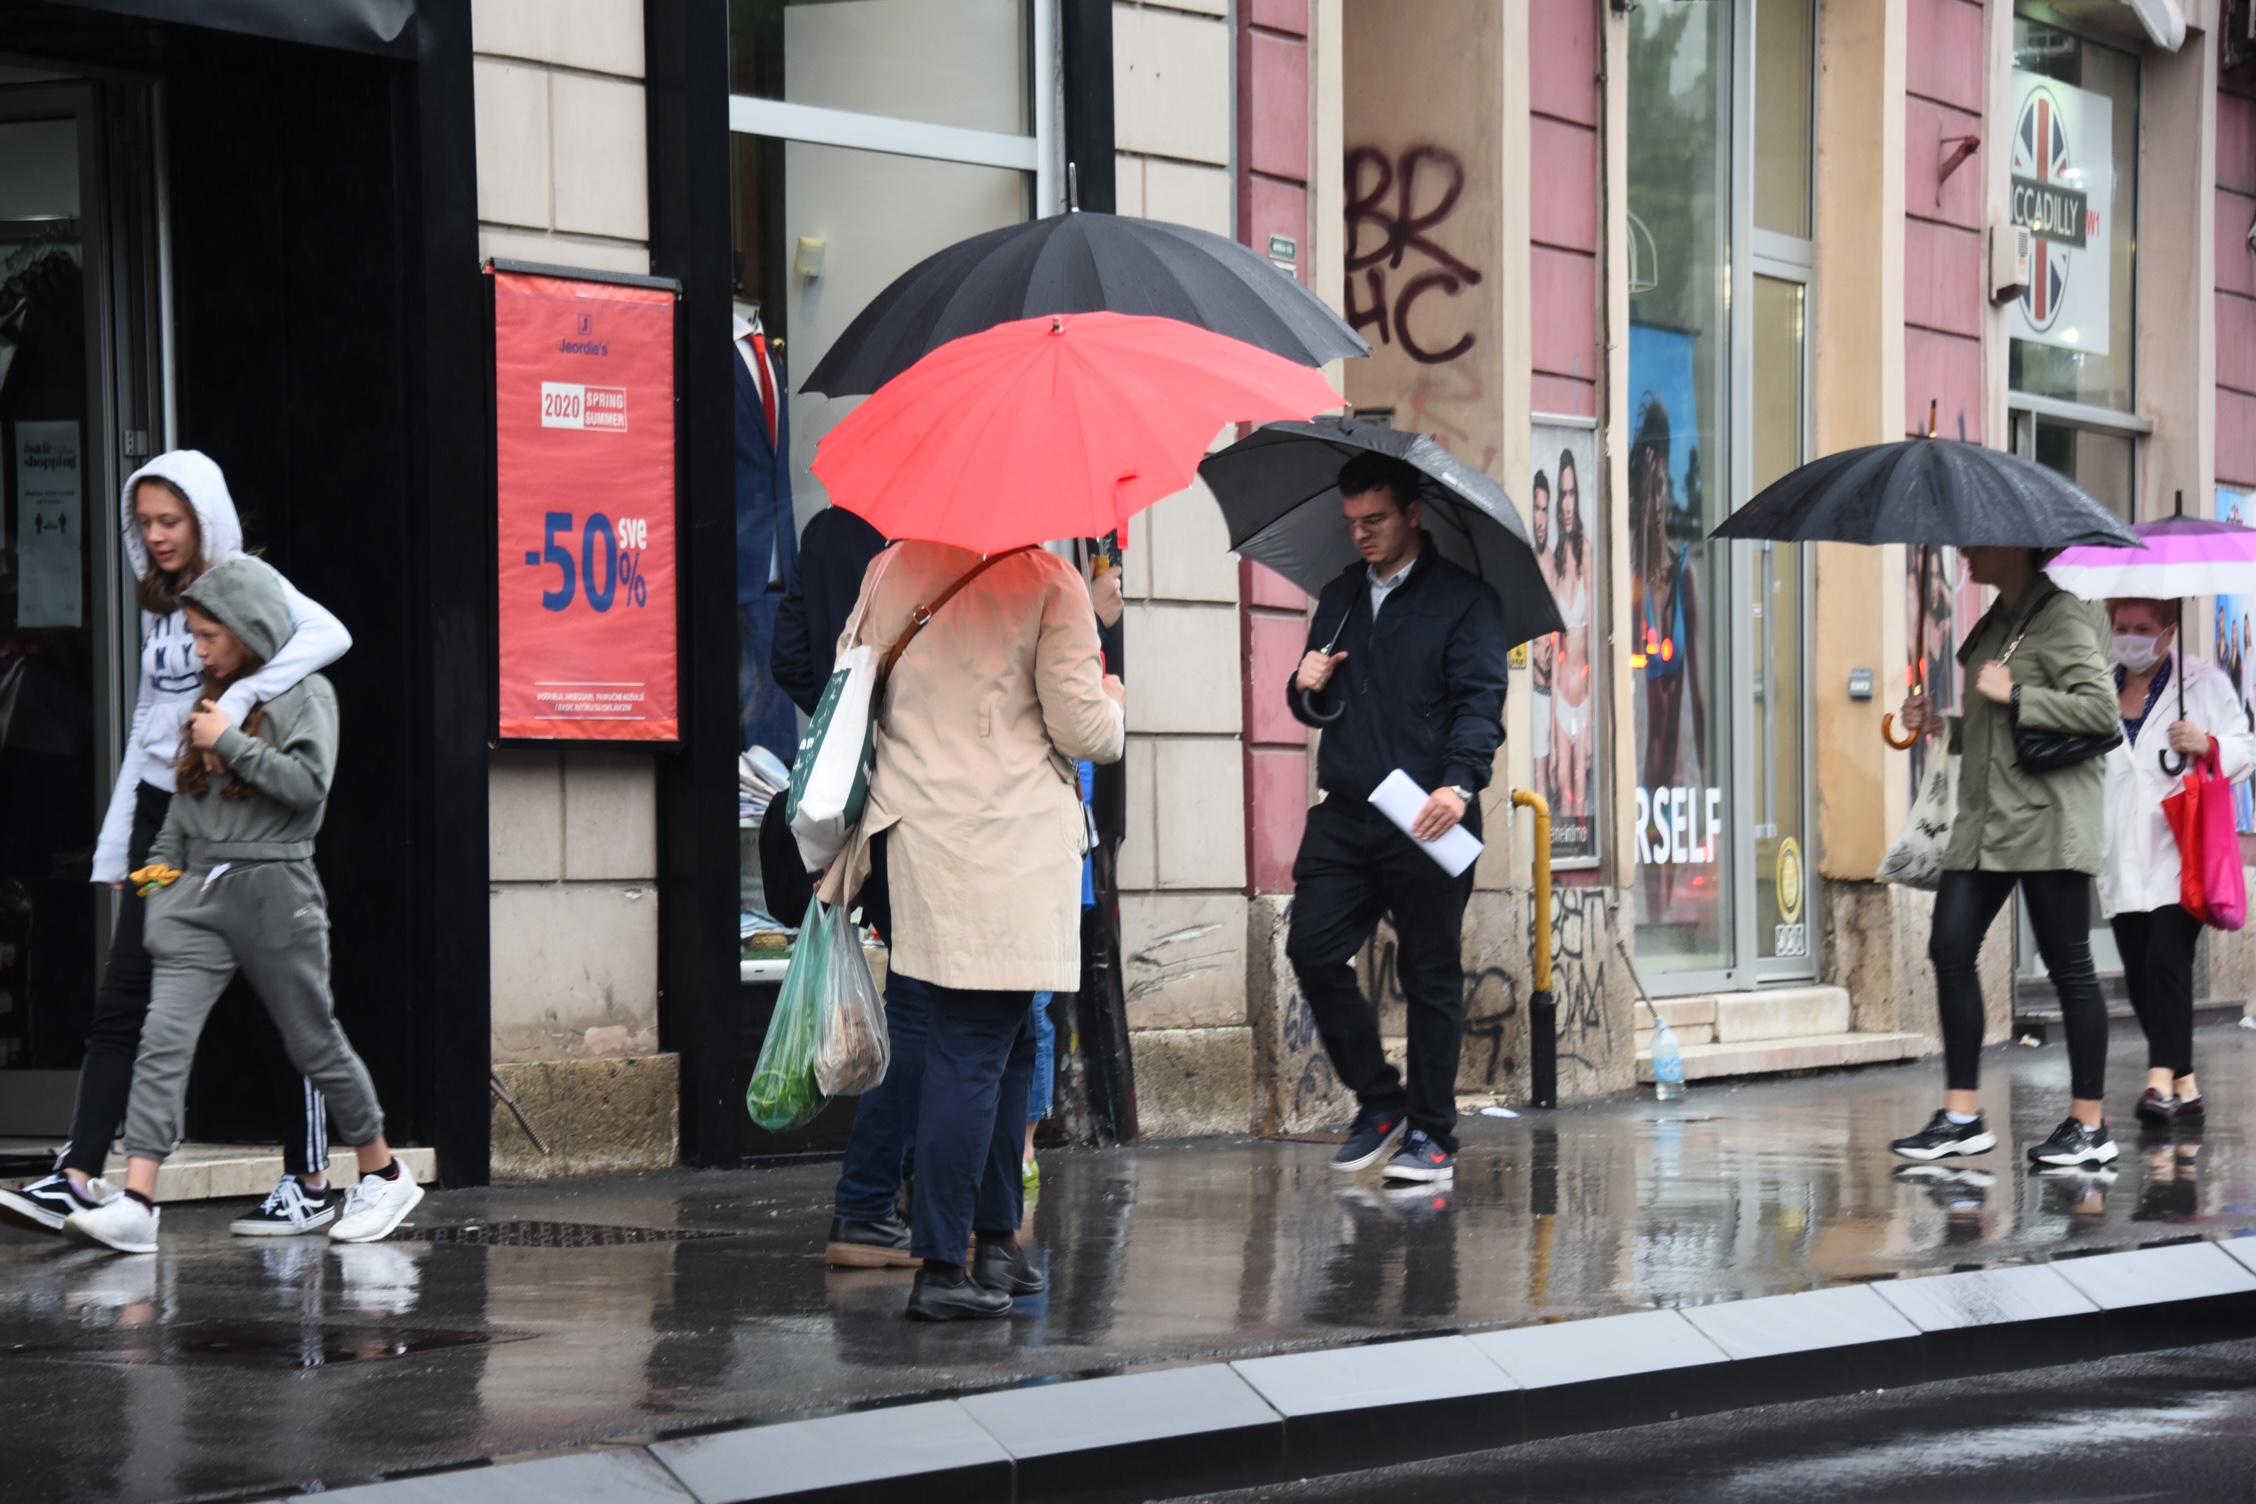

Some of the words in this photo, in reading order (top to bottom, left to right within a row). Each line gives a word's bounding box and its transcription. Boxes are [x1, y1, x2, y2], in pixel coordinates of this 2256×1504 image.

[559, 338, 609, 357] Jeordie's
[544, 393, 580, 418] 2020
[586, 391, 624, 409] SPRING
[585, 411, 626, 427] SUMMER
[618, 517, 648, 550] sve
